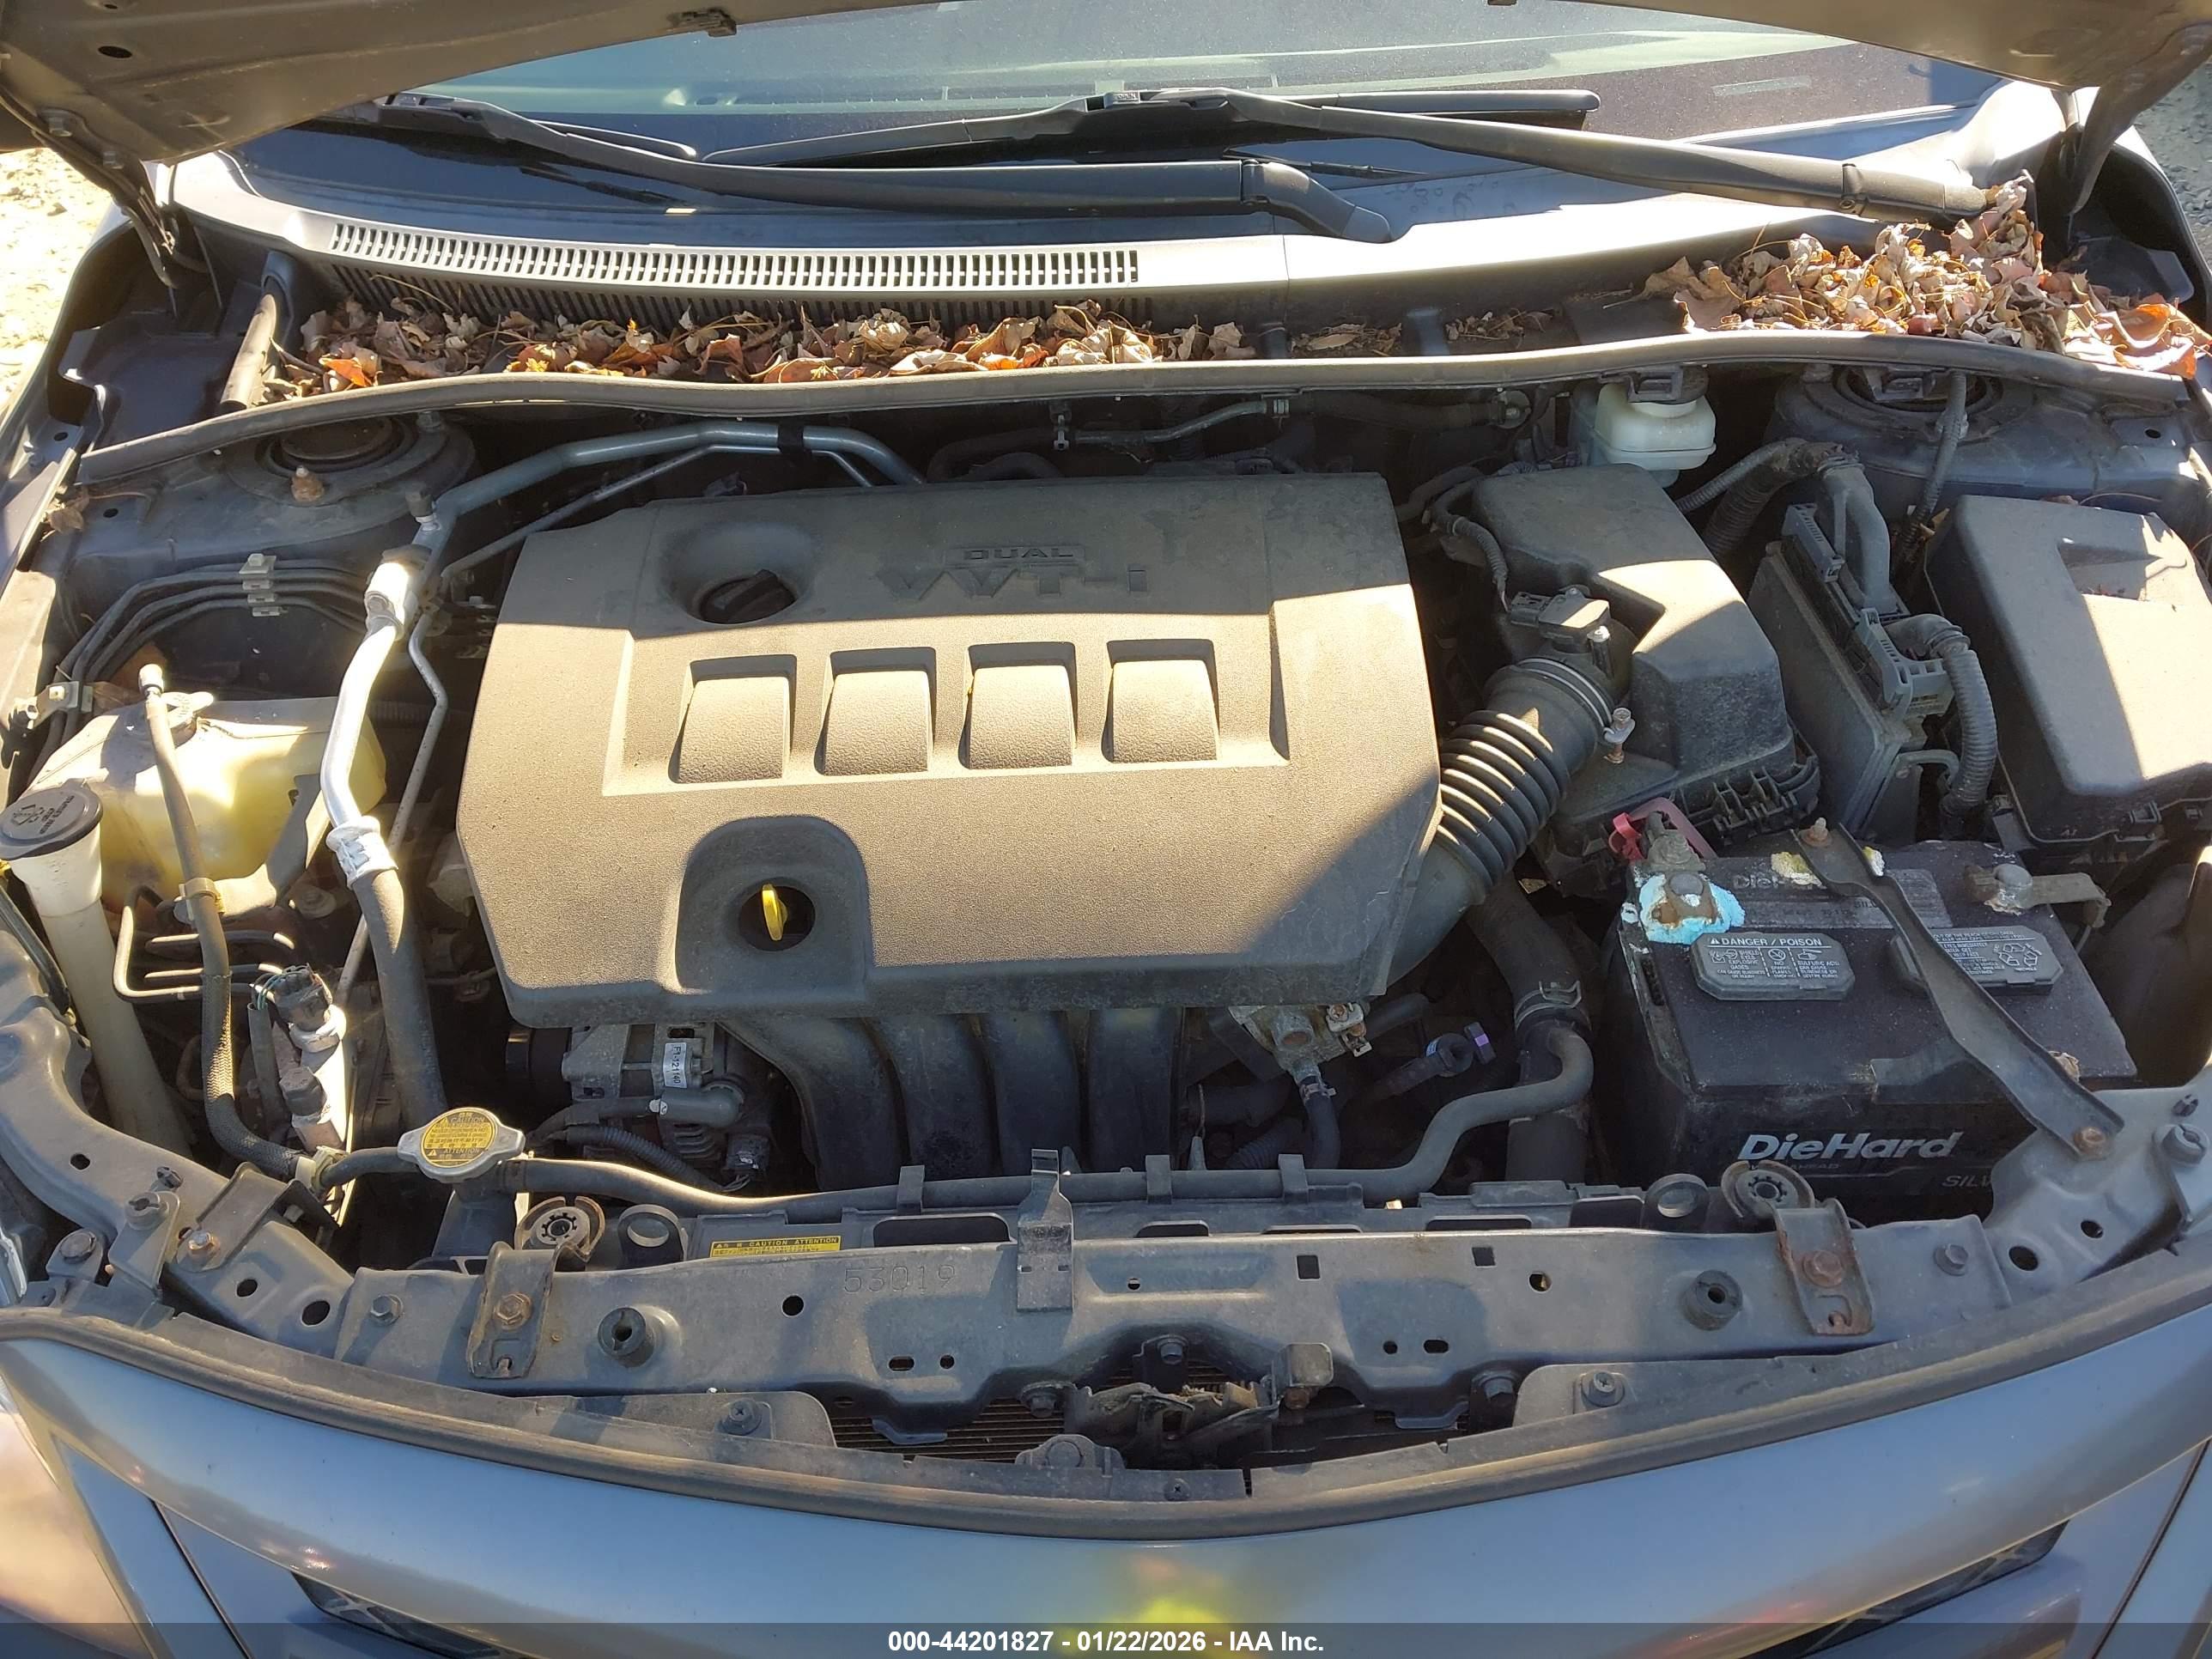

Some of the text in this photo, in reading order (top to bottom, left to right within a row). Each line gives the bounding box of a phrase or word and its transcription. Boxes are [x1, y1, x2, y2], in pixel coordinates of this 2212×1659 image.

[963, 548, 1074, 560] DUAL
[1721, 938, 1822, 946] DANGER / POISON
[1737, 1132, 1965, 1160] DieHard
[794, 1237, 838, 1245] ATTENTION
[843, 1264, 956, 1295] 53019
